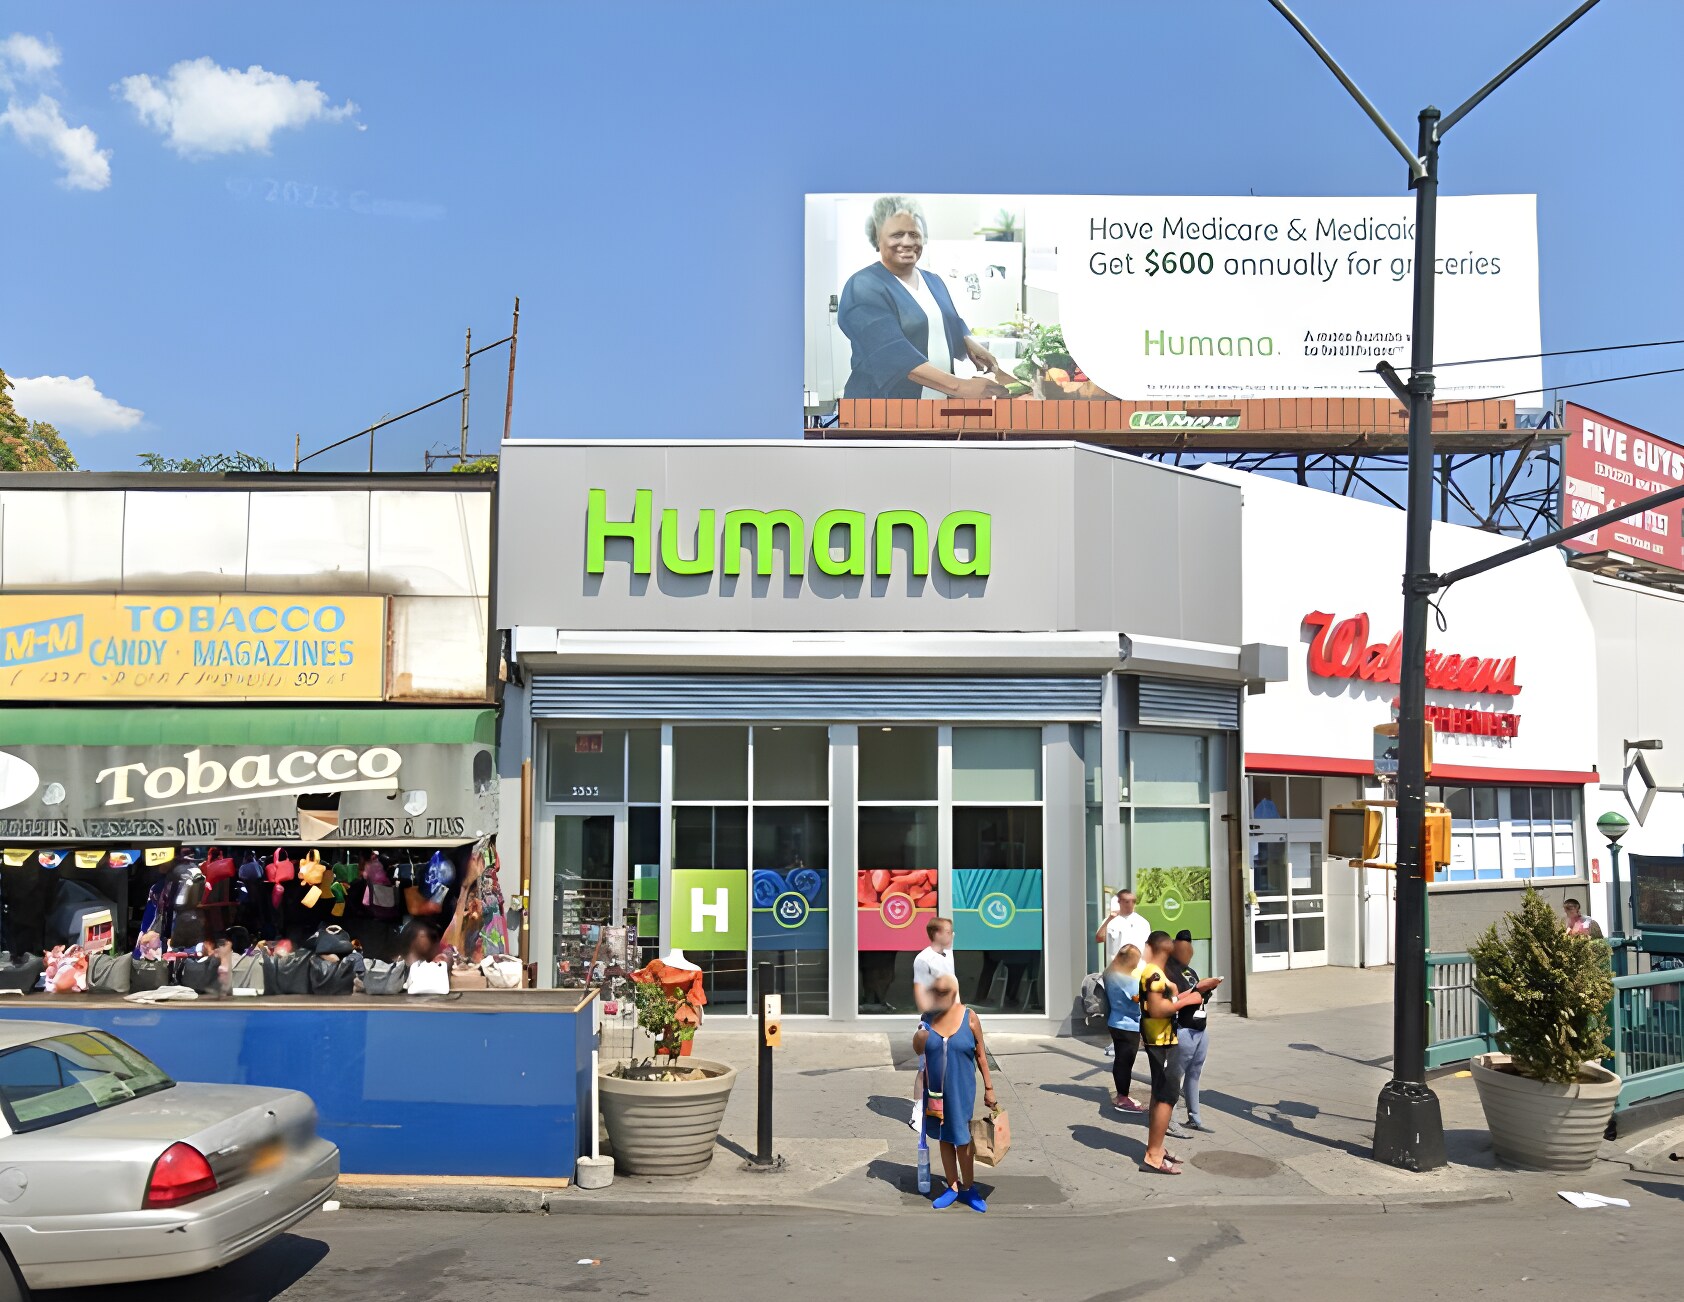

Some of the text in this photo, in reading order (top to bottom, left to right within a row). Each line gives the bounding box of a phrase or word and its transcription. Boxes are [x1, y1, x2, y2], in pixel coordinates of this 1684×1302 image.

[1090, 217, 1154, 241] Have
[1163, 216, 1279, 241] Medicare
[1287, 218, 1307, 241] &
[1089, 249, 1501, 282] Get $600 annually for grceries
[1582, 418, 1628, 462] FIVE
[1633, 438, 1684, 482] GUYS
[586, 488, 992, 577] Humana
[124, 605, 346, 633] TOBACCO
[5, 620, 78, 661] M-M
[89, 637, 355, 667] CANDY MAGAZINES
[95, 747, 402, 806] Tobacco
[690, 887, 729, 933] H
